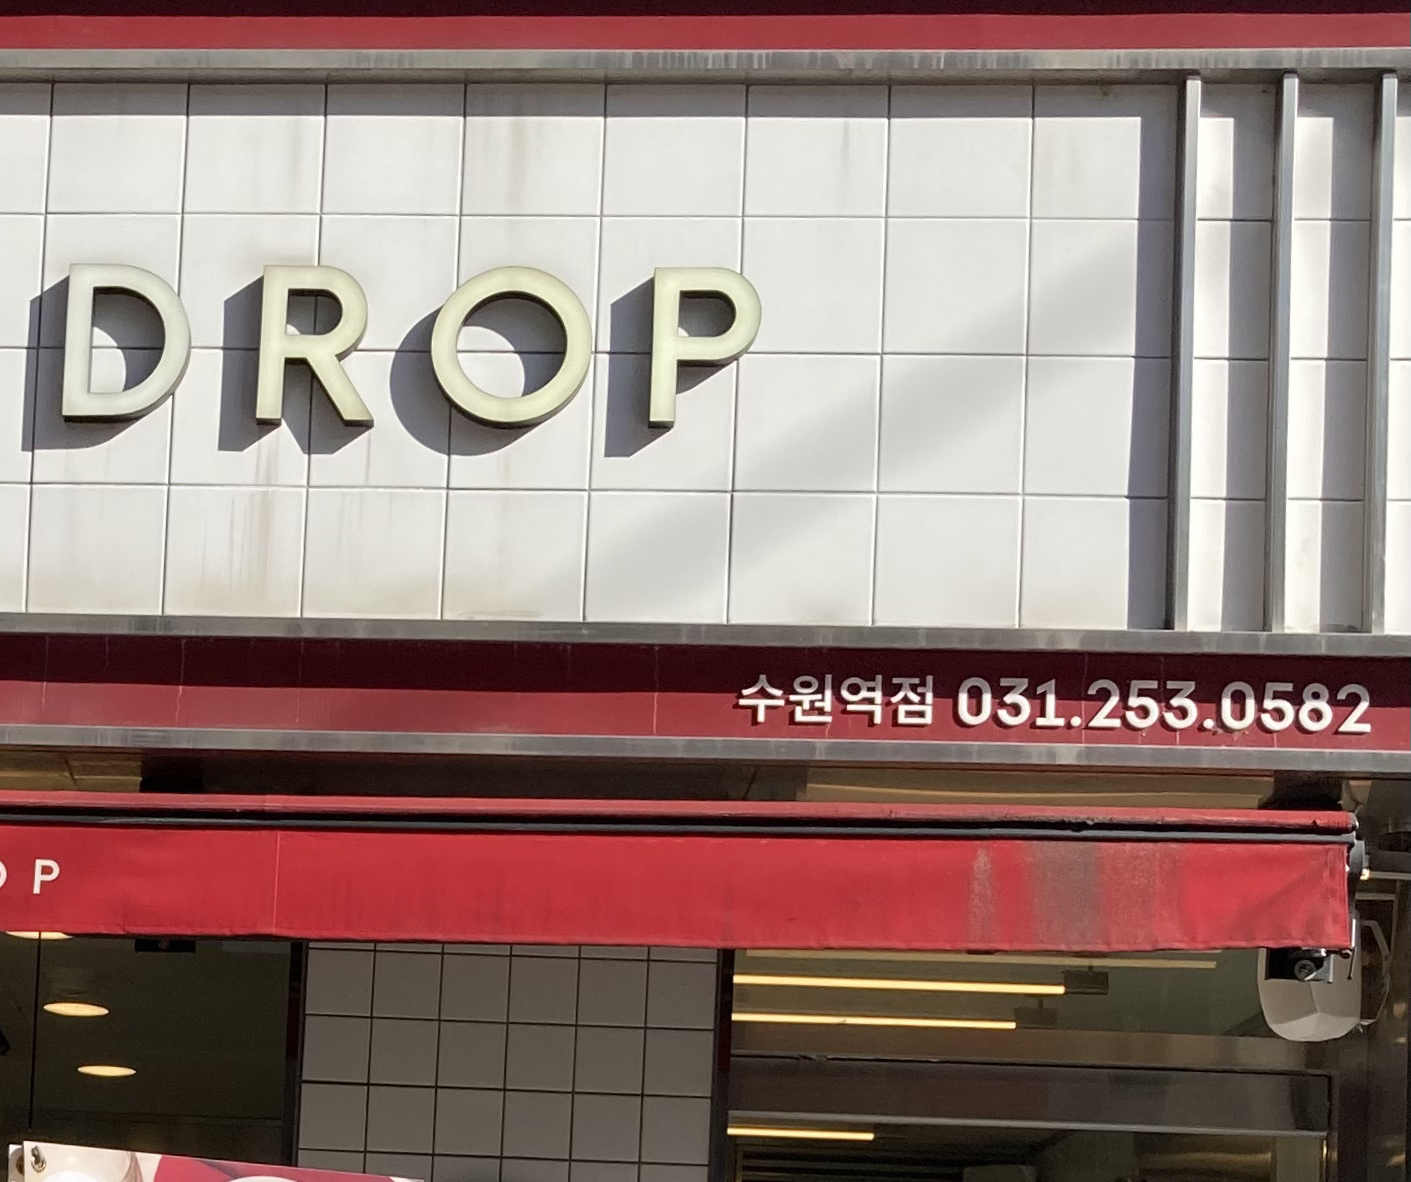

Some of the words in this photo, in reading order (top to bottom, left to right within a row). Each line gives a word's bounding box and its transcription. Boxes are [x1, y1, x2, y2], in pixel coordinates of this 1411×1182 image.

[61, 262, 762, 430] DROP
[737, 673, 935, 728] 수원역점
[956, 676, 1373, 735] 031.253.0582
